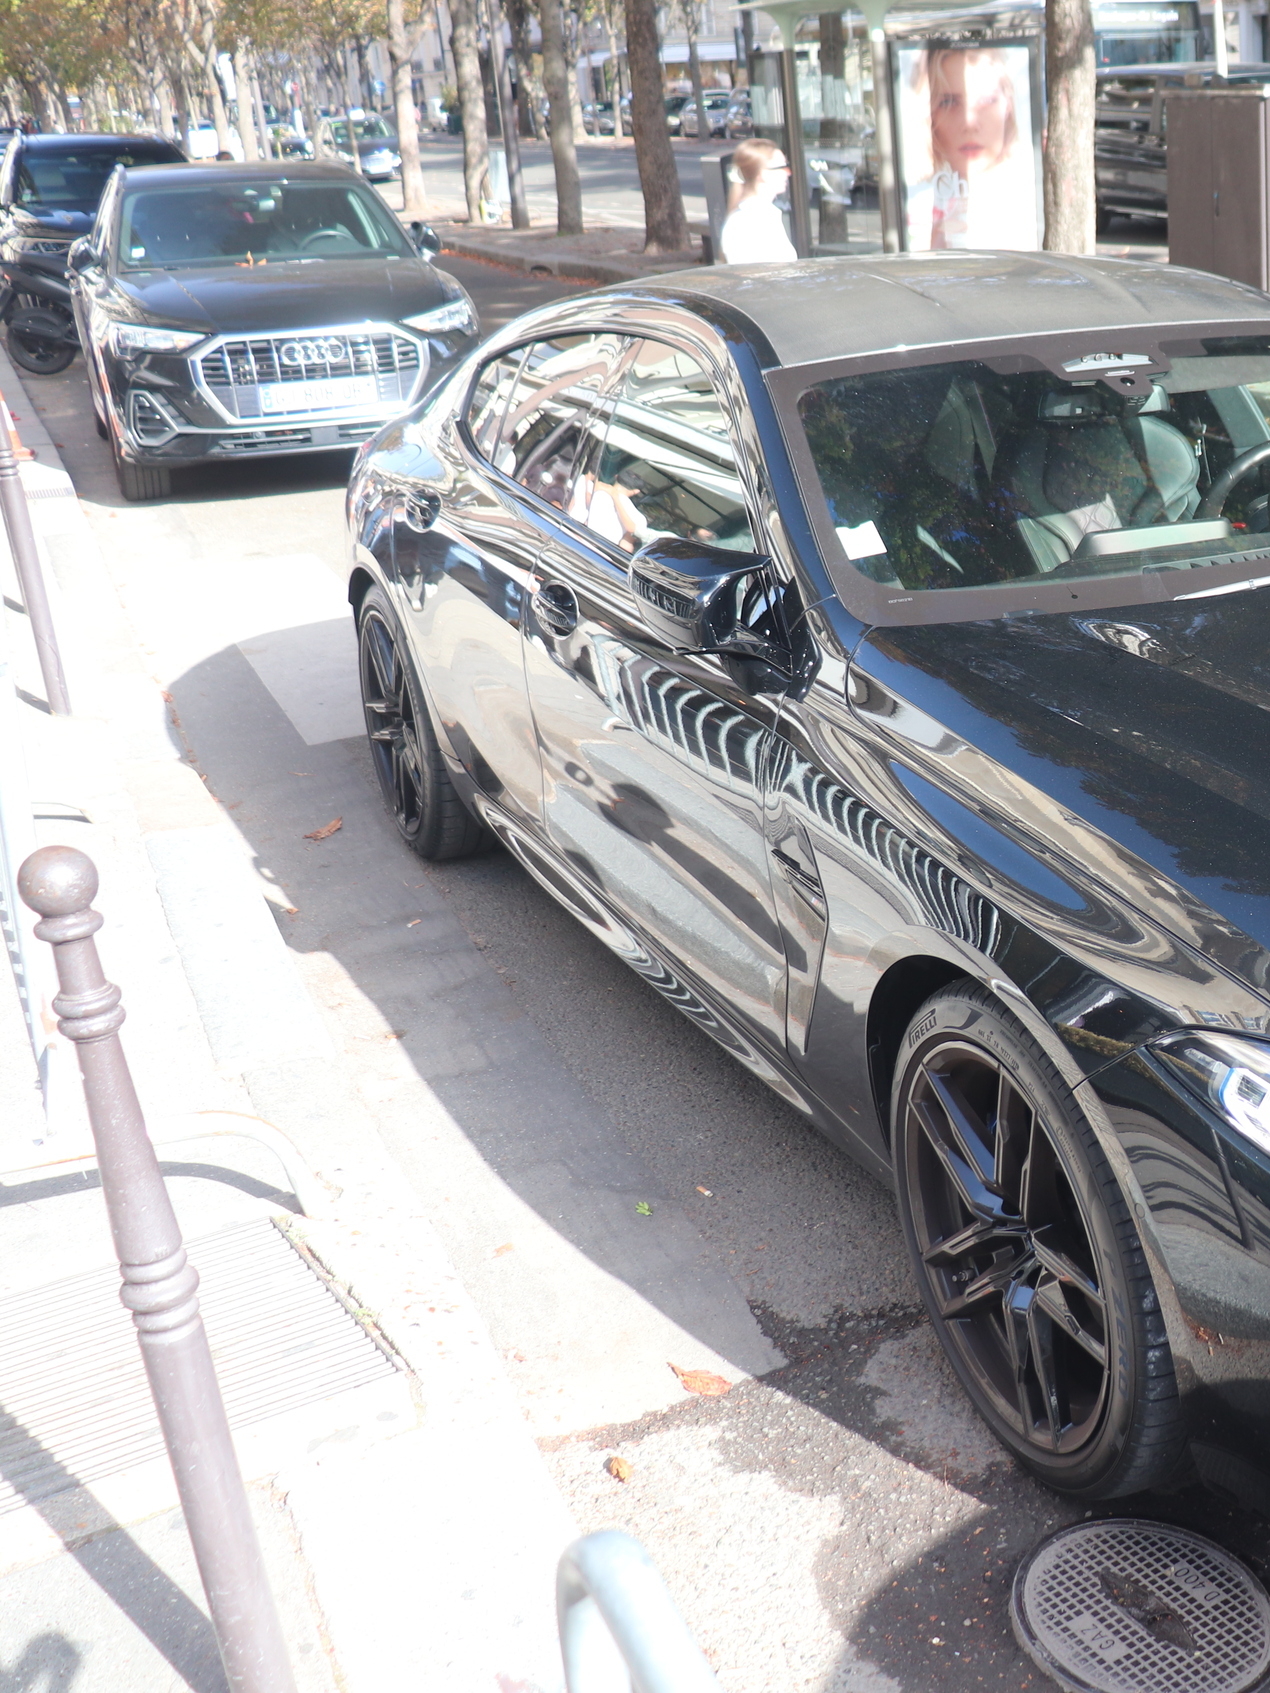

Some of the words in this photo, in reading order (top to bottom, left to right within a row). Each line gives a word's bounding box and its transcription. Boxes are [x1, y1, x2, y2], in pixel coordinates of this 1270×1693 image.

[908, 1007, 937, 1049] PIRELLI
[1174, 1567, 1206, 1589] 400
[1081, 1623, 1115, 1650] GAZ
